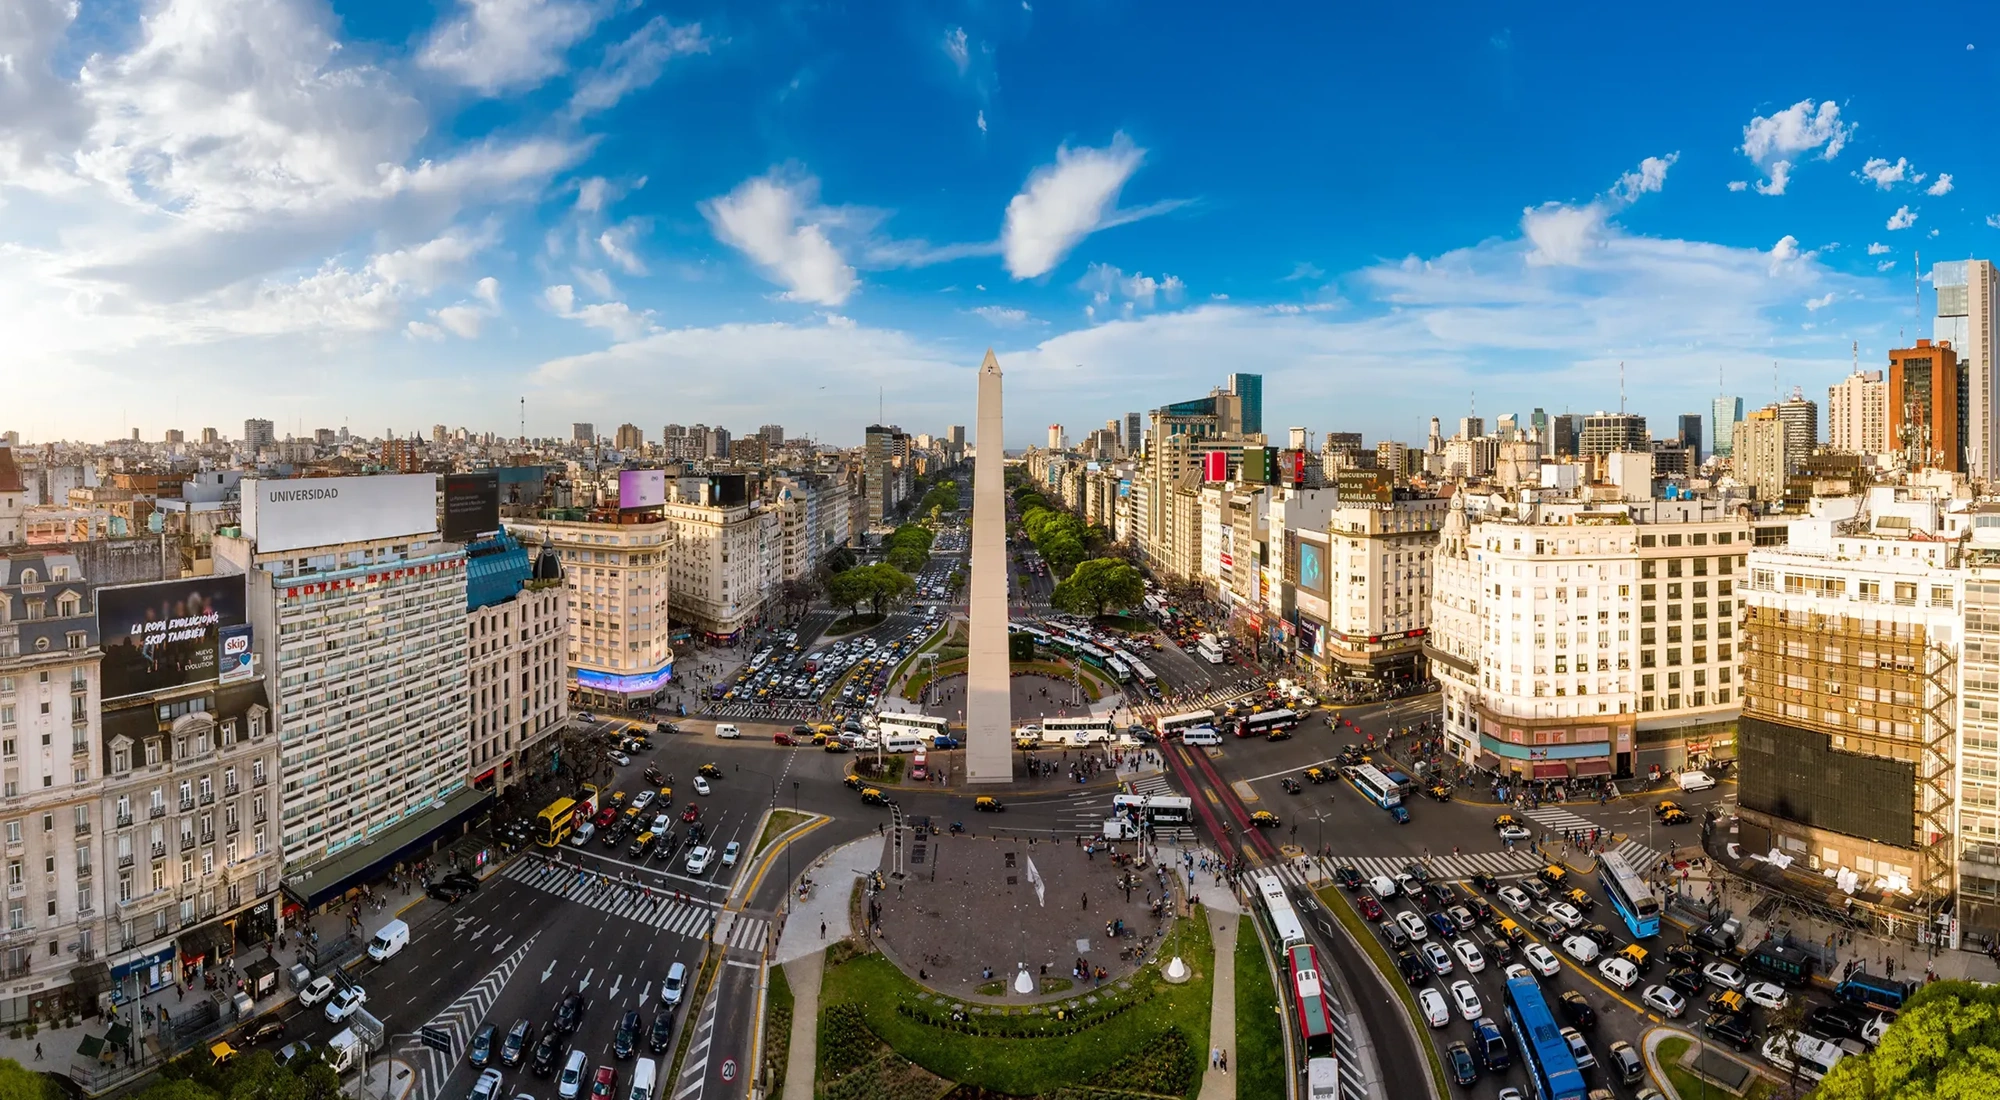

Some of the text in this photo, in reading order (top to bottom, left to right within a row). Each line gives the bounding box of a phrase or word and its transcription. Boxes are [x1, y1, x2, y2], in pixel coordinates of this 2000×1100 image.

[270, 488, 339, 502] UNIVERSIDAD
[287, 559, 466, 598] HOTEL REPUBLICA
[131, 623, 142, 635] LA
[144, 620, 167, 633] ROPA
[145, 628, 207, 645] SKIP TAMBIÉN
[227, 638, 246, 650] skip
[195, 648, 214, 656] NUEVO
[184, 660, 214, 671] EVOLUTION
[723, 1062, 735, 1077] 20
